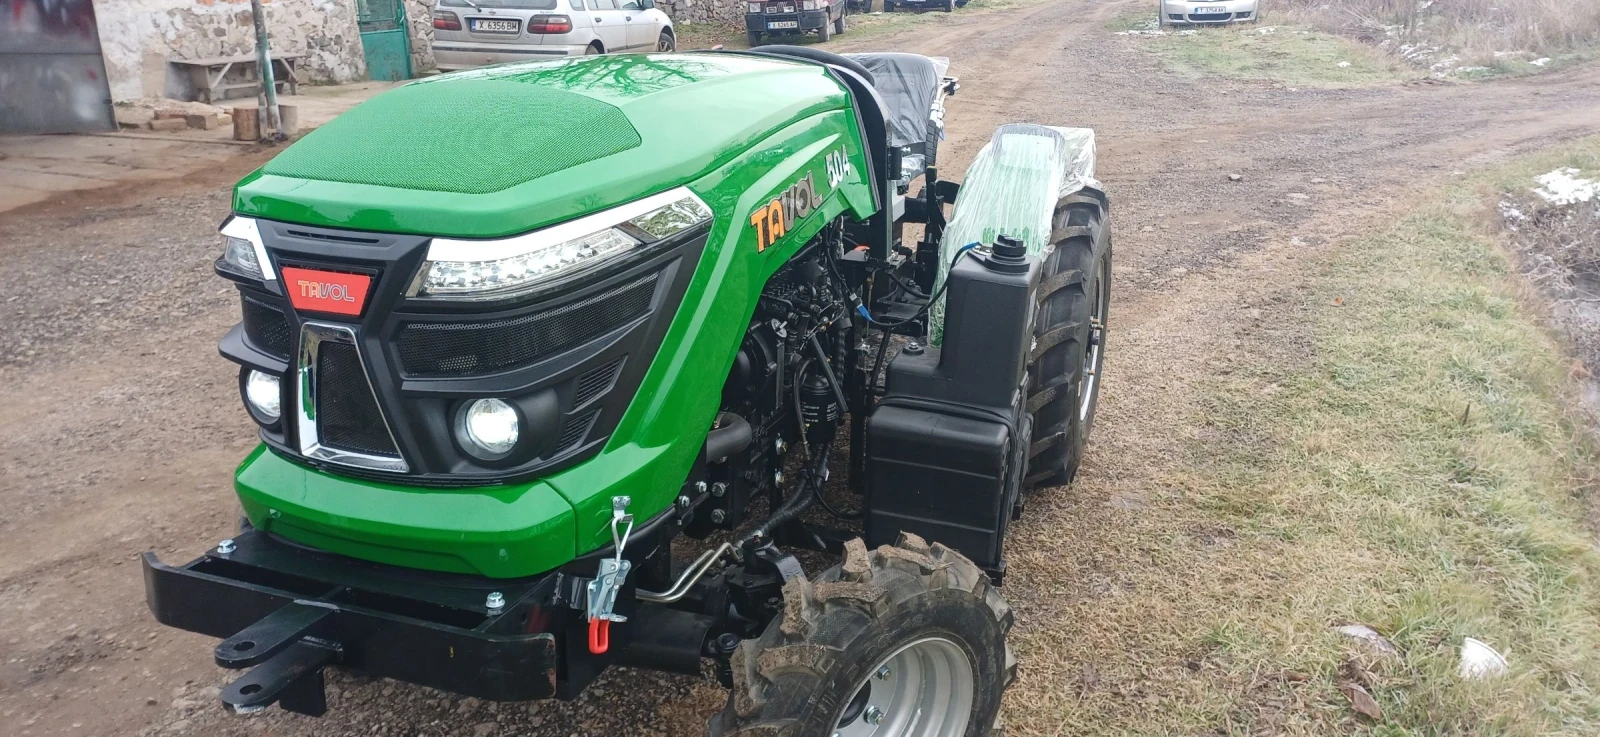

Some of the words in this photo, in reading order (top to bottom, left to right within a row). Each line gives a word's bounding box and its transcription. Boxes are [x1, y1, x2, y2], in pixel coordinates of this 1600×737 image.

[479, 21, 484, 29] X
[488, 21, 506, 30] 6356
[507, 21, 517, 30] BM
[750, 169, 823, 254] TAVOL
[825, 144, 850, 188] 504
[298, 280, 355, 302] TAVOL
